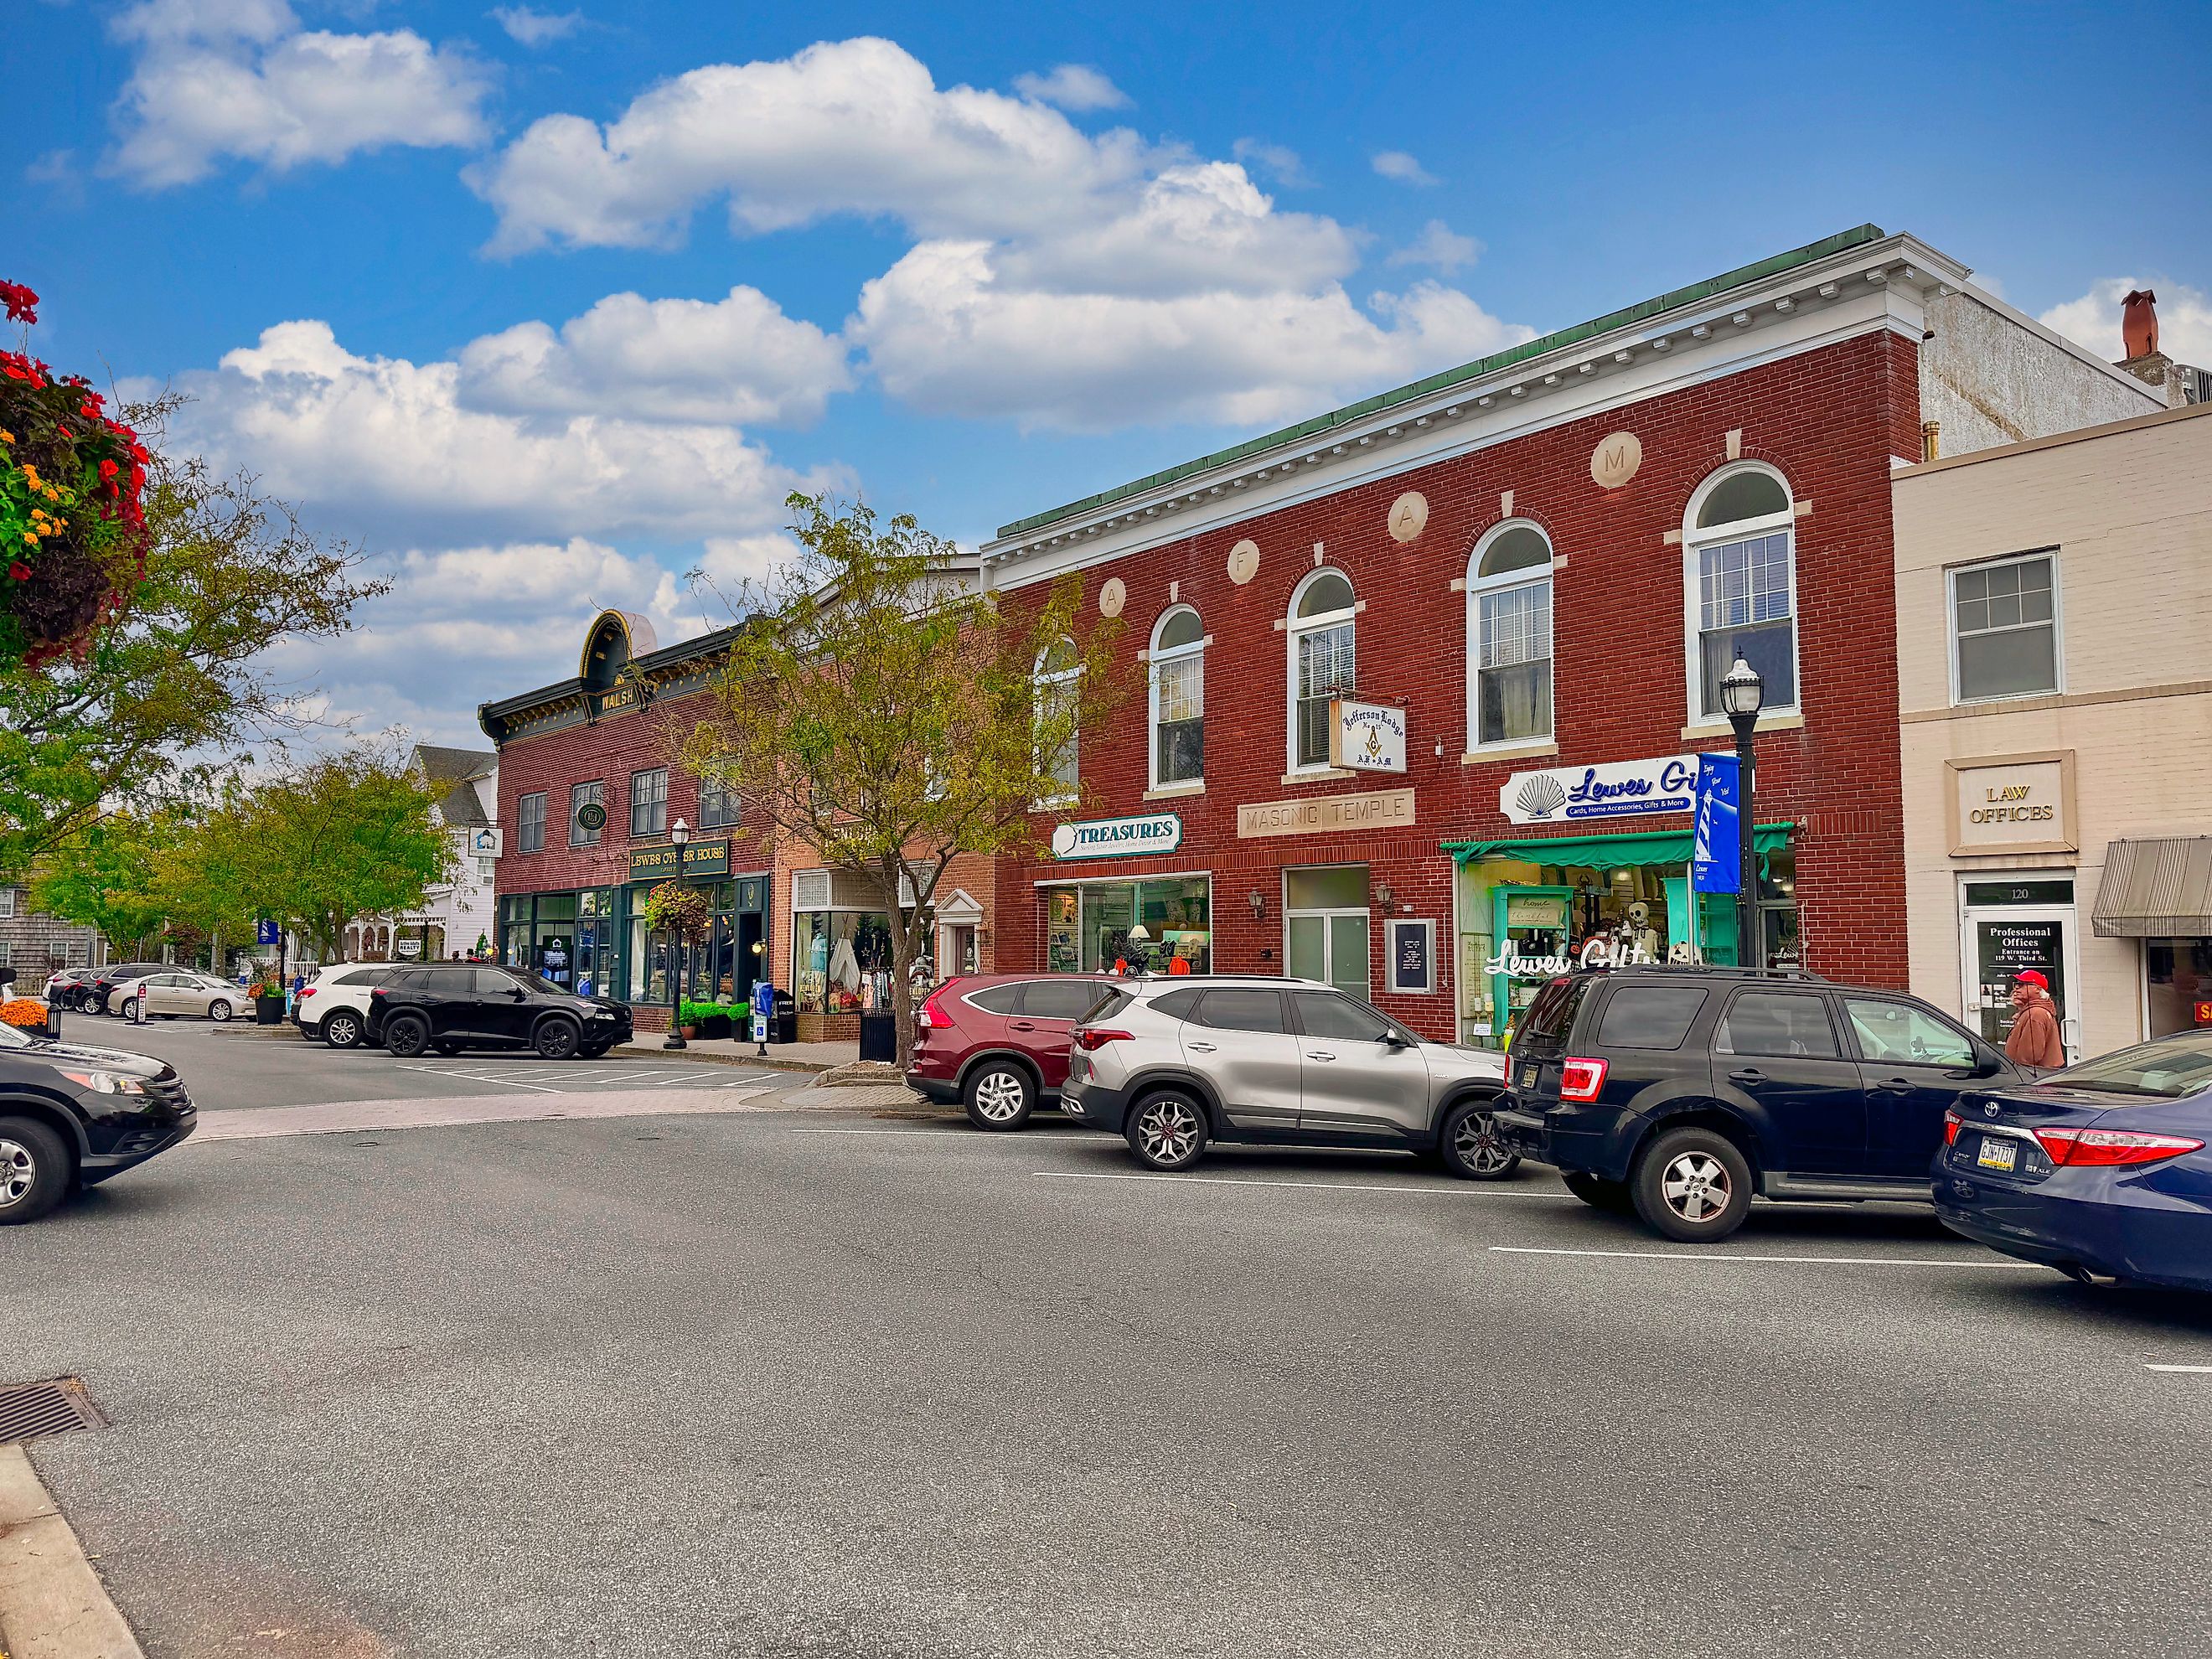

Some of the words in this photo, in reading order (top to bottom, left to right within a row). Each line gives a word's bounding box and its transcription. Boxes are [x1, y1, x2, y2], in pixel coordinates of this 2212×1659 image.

[1237, 550, 1248, 572] F
[1398, 504, 1415, 528] A
[1604, 445, 1625, 473] M
[602, 689, 634, 711] WALSH
[1342, 709, 1381, 731] Jefferson
[1380, 710, 1403, 738] Lodge
[1567, 768, 1653, 802] Lewes
[1986, 785, 2030, 802] LAW
[1246, 806, 1317, 830] MASONIC
[1331, 798, 1405, 822] TEMPLE
[1569, 807, 1588, 815] Cards,
[1589, 805, 1606, 814] Home
[1607, 803, 1644, 812] Accessories,
[1970, 805, 2054, 824] OFFICES
[1078, 820, 1173, 844] TREASURES
[630, 853, 661, 867] LEWES
[697, 846, 725, 861] HOUSE
[2012, 888, 2029, 899] 120
[1990, 928, 2051, 937] Professional
[2002, 938, 2039, 947] Offices
[1483, 938, 1573, 977] Lewes
[2200, 1005, 2212, 1019] S
